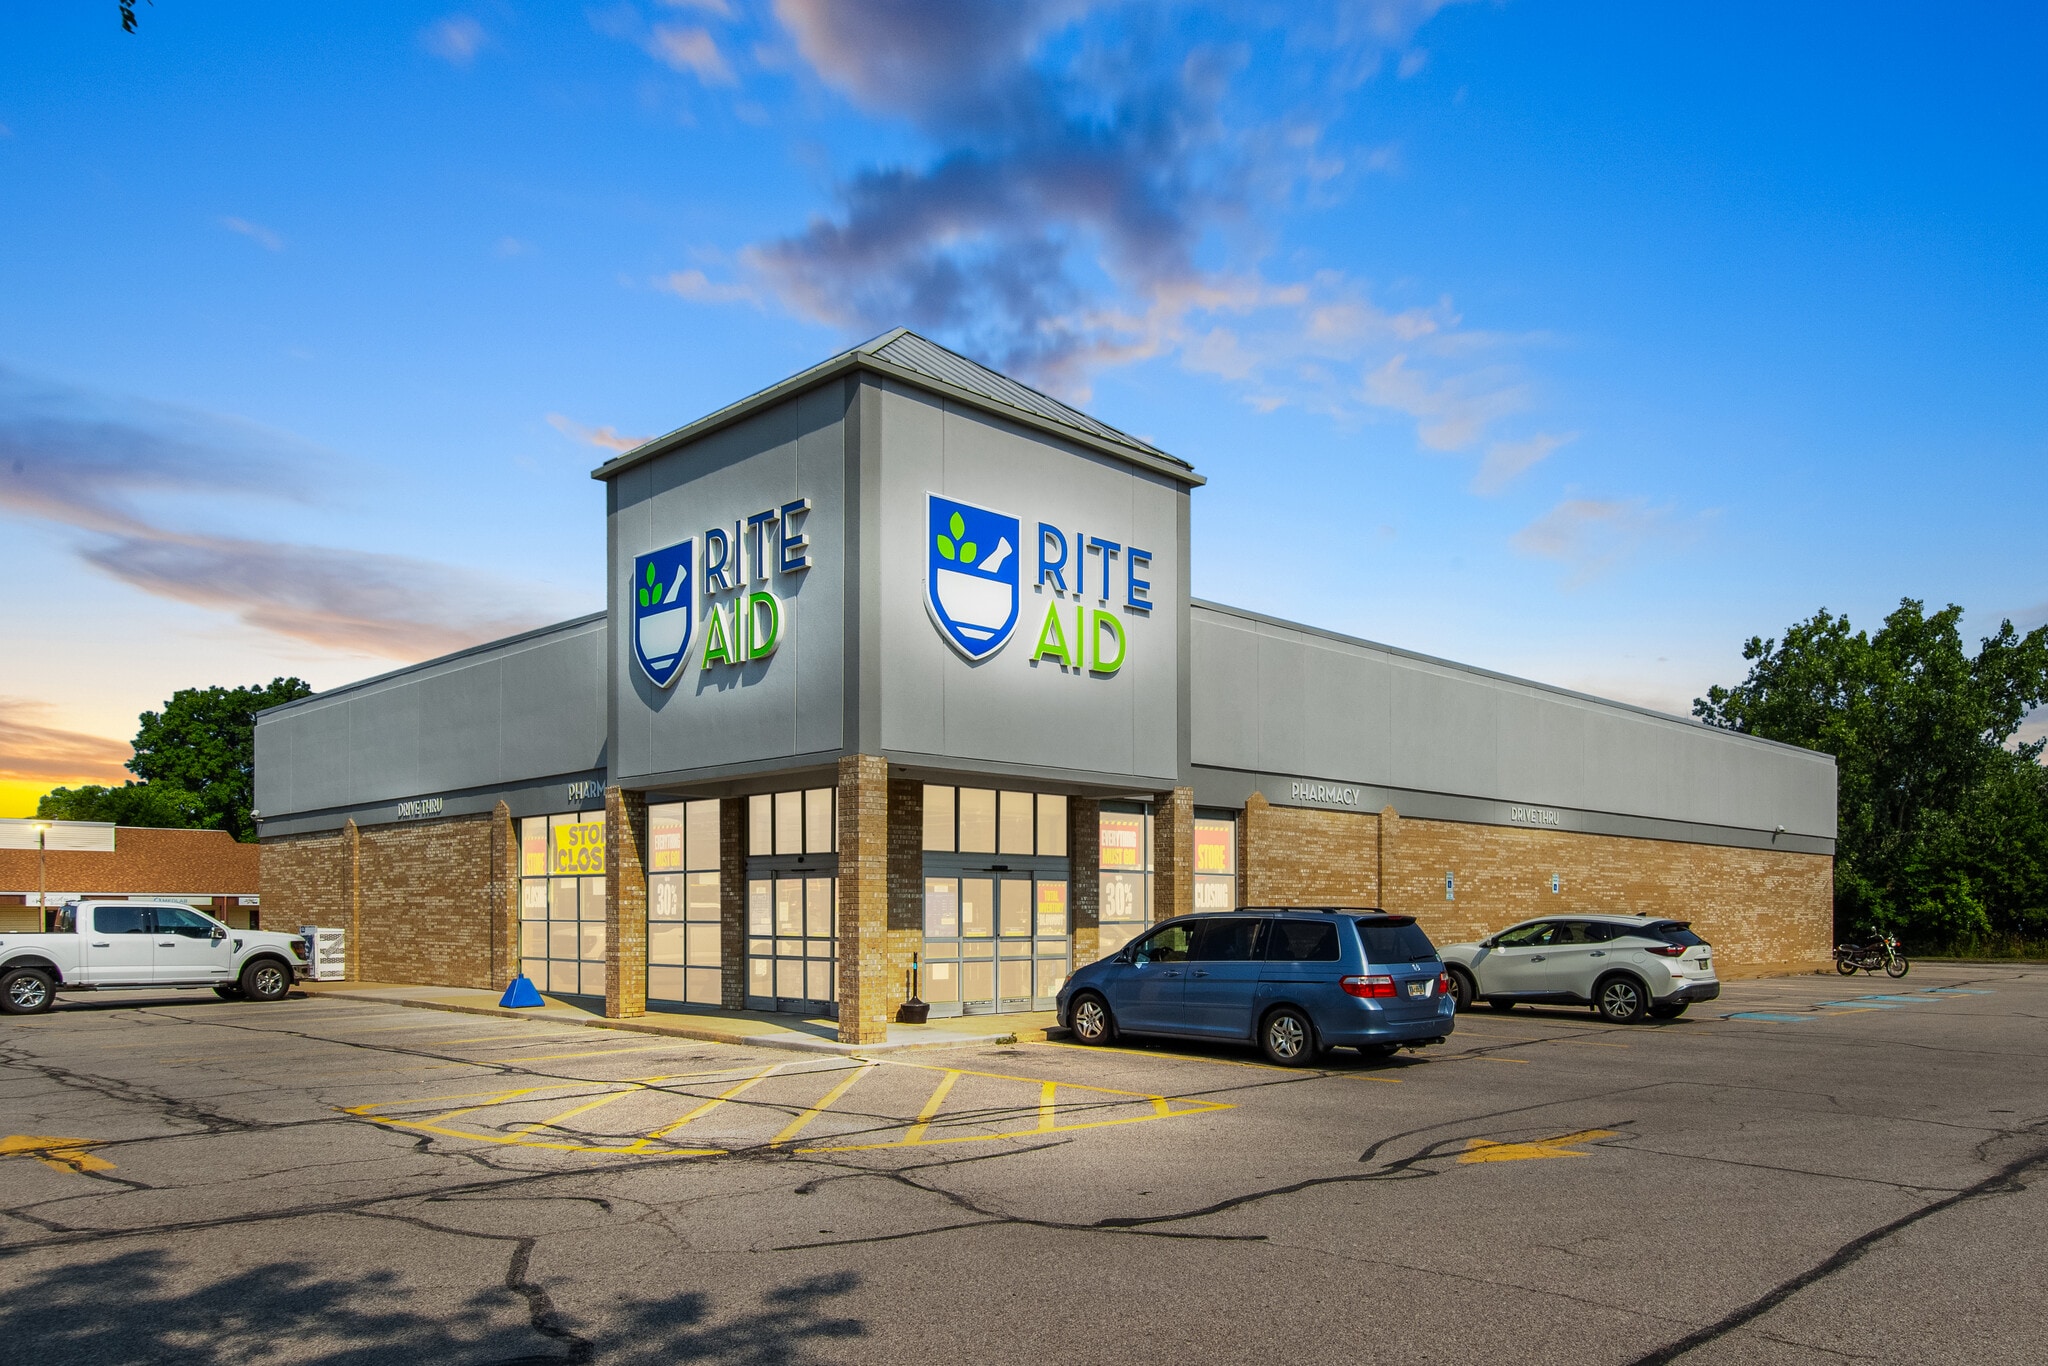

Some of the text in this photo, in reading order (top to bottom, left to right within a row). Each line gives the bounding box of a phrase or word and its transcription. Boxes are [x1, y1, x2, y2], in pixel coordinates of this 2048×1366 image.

[704, 498, 812, 594] RITE
[1034, 521, 1153, 615] RITE
[701, 591, 785, 670] AID
[1030, 599, 1127, 676] AID
[1291, 782, 1360, 805] PHARMACY
[398, 797, 443, 817] DRIVE THRU
[1511, 807, 1560, 826] DRIVE THRU
[1101, 830, 1136, 848] EVERYTHING
[527, 852, 545, 875] STORE
[558, 846, 606, 872] CLOS
[1102, 848, 1122, 865] MUST
[1197, 844, 1226, 870] STORE
[1194, 883, 1229, 908] CLOSING
